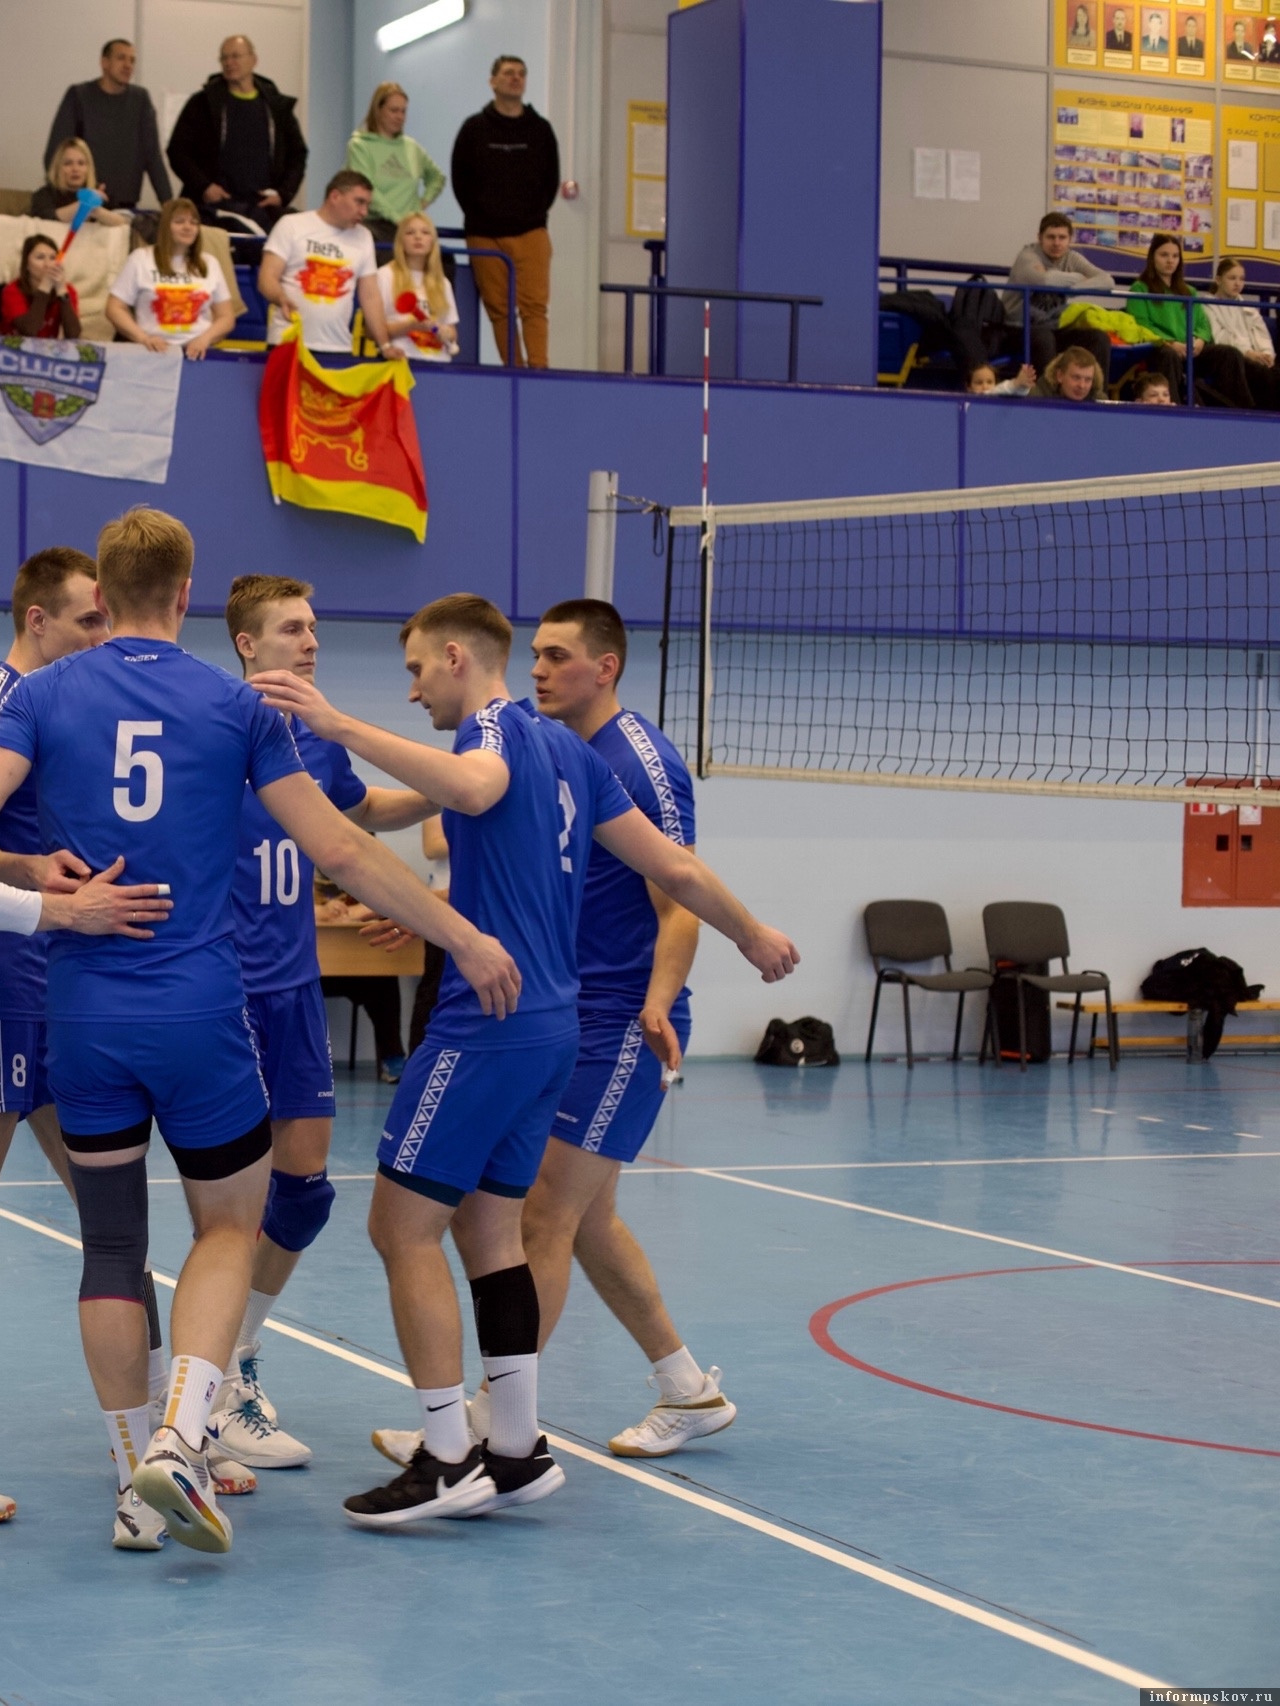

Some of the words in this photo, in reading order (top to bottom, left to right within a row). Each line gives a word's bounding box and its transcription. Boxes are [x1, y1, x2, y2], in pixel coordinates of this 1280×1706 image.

[113, 720, 164, 822] 5
[253, 838, 300, 906] 10
[12, 1053, 27, 1087] 8
